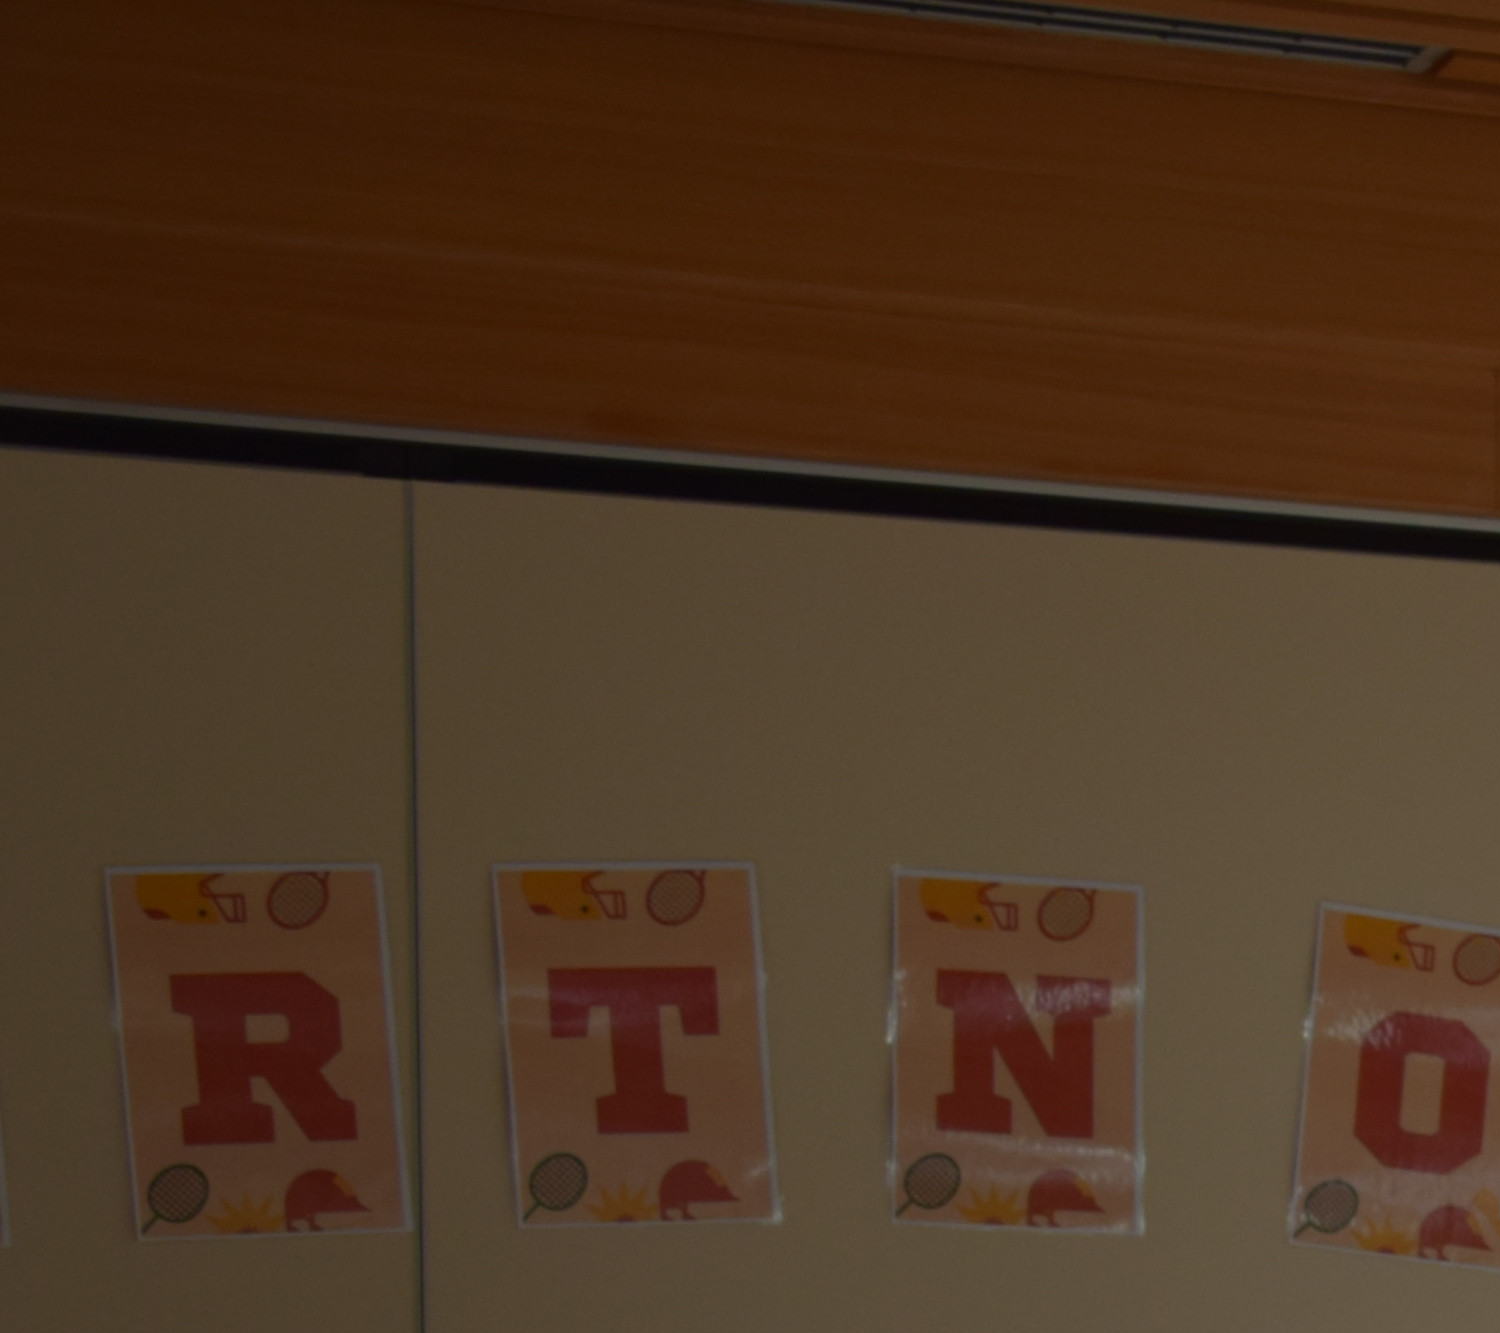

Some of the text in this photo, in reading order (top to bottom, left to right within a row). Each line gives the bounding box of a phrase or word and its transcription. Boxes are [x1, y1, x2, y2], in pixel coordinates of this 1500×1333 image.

[170, 965, 1493, 1176] R T N O
